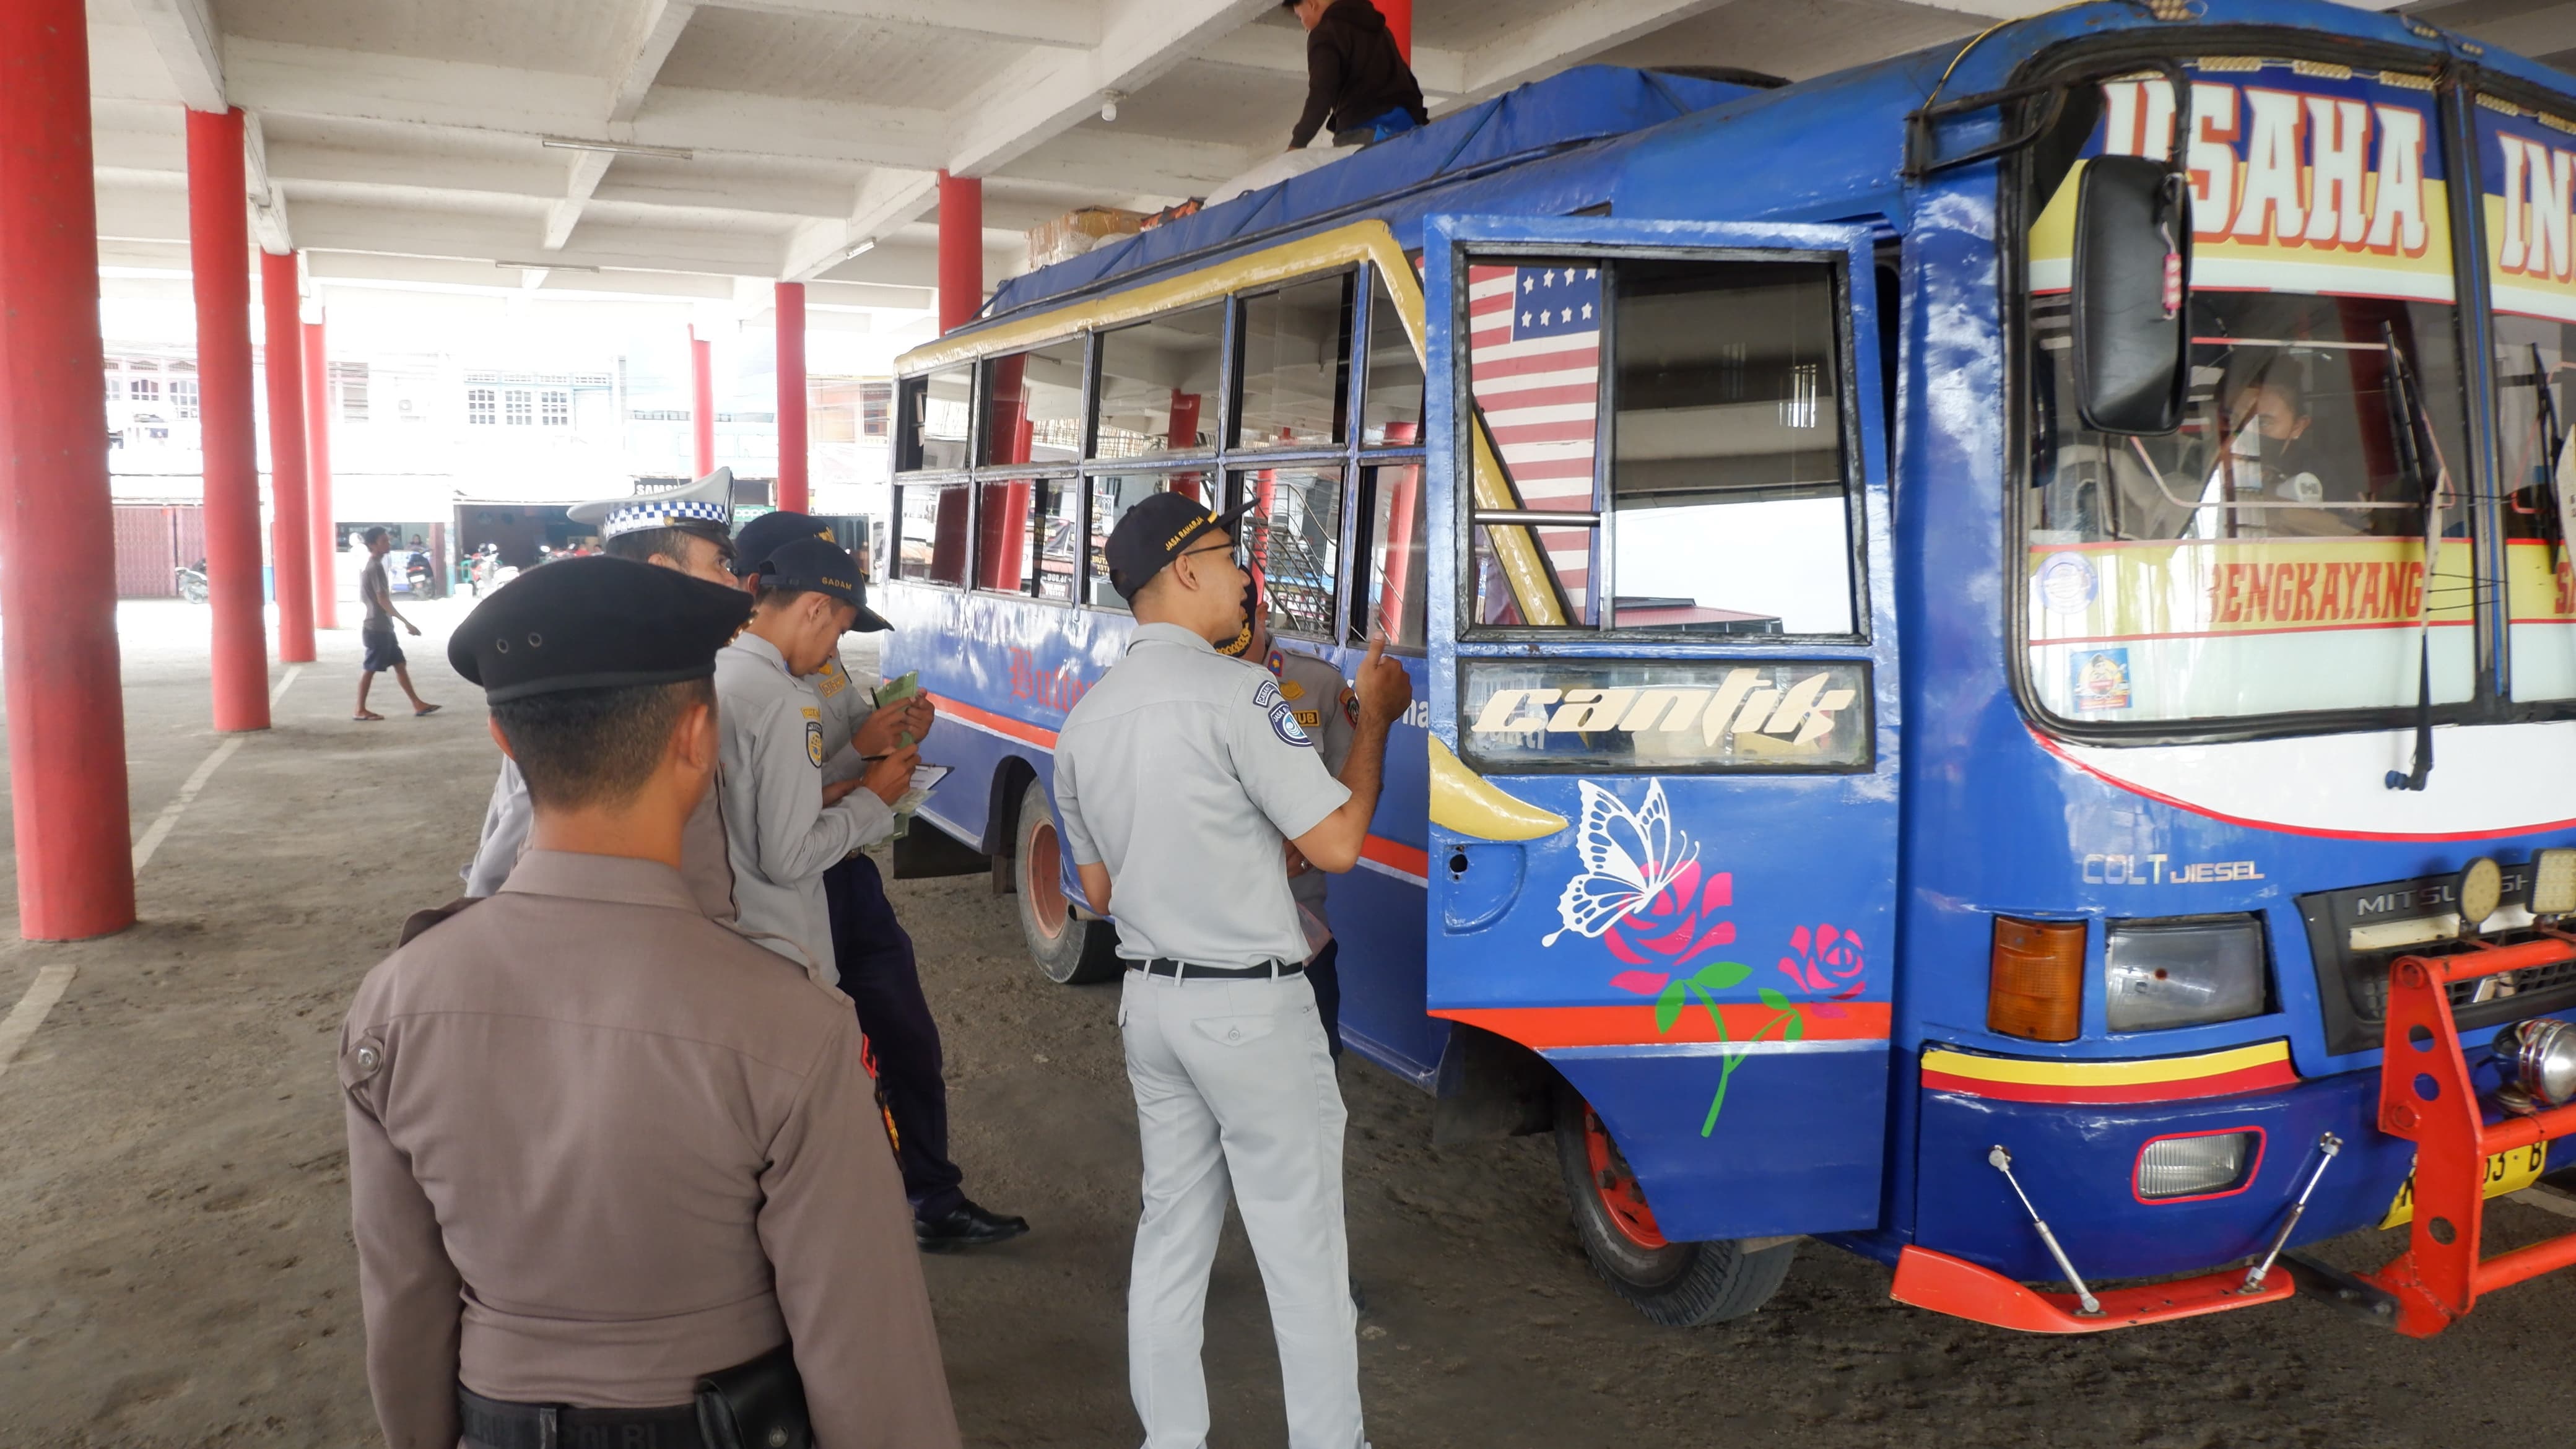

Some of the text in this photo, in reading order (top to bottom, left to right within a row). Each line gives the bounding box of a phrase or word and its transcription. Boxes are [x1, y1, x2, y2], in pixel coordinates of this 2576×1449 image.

[2496, 129, 2576, 285] IN
[636, 484, 681, 495] SAMS
[1165, 515, 1204, 552] JASA RAHARJA
[2554, 560, 2576, 614] S
[1007, 646, 1095, 714] Butte
[1273, 709, 1285, 723] JASA
[2082, 853, 2167, 885] COLT
